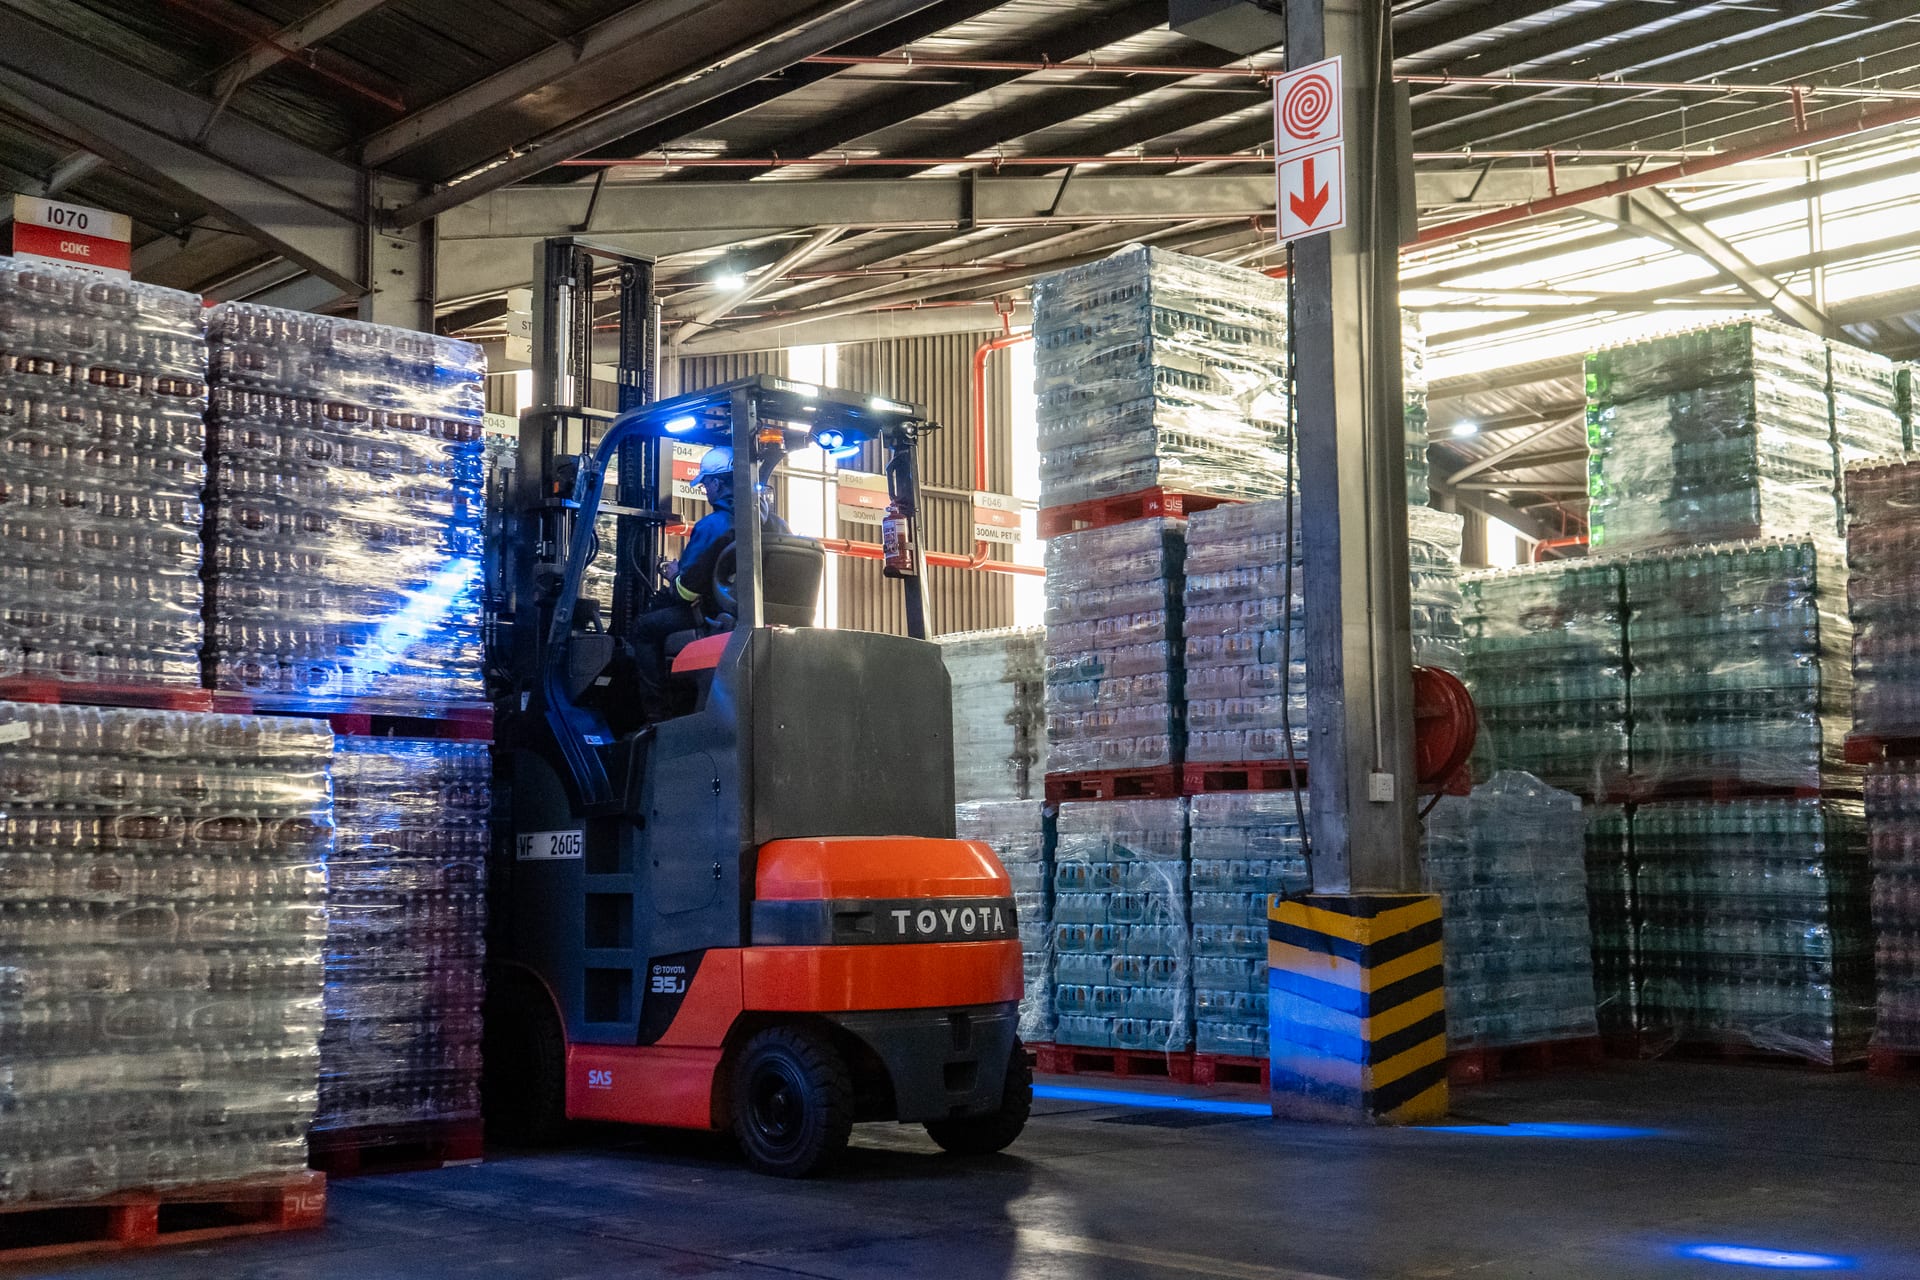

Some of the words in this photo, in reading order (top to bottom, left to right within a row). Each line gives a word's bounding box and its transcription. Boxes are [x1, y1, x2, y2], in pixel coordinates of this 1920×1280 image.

[47, 206, 88, 229] I070
[60, 241, 90, 257] COKE
[482, 416, 506, 429] F043
[982, 496, 1001, 508] F046
[853, 510, 876, 521] 300ml
[976, 527, 999, 538] 300ML
[1000, 531, 1013, 540] PET
[550, 834, 580, 855] 2605
[891, 906, 1005, 934] TOYOTA
[662, 965, 686, 974] TOYOTA
[651, 976, 686, 993] 35J
[588, 1070, 612, 1085] SAS
